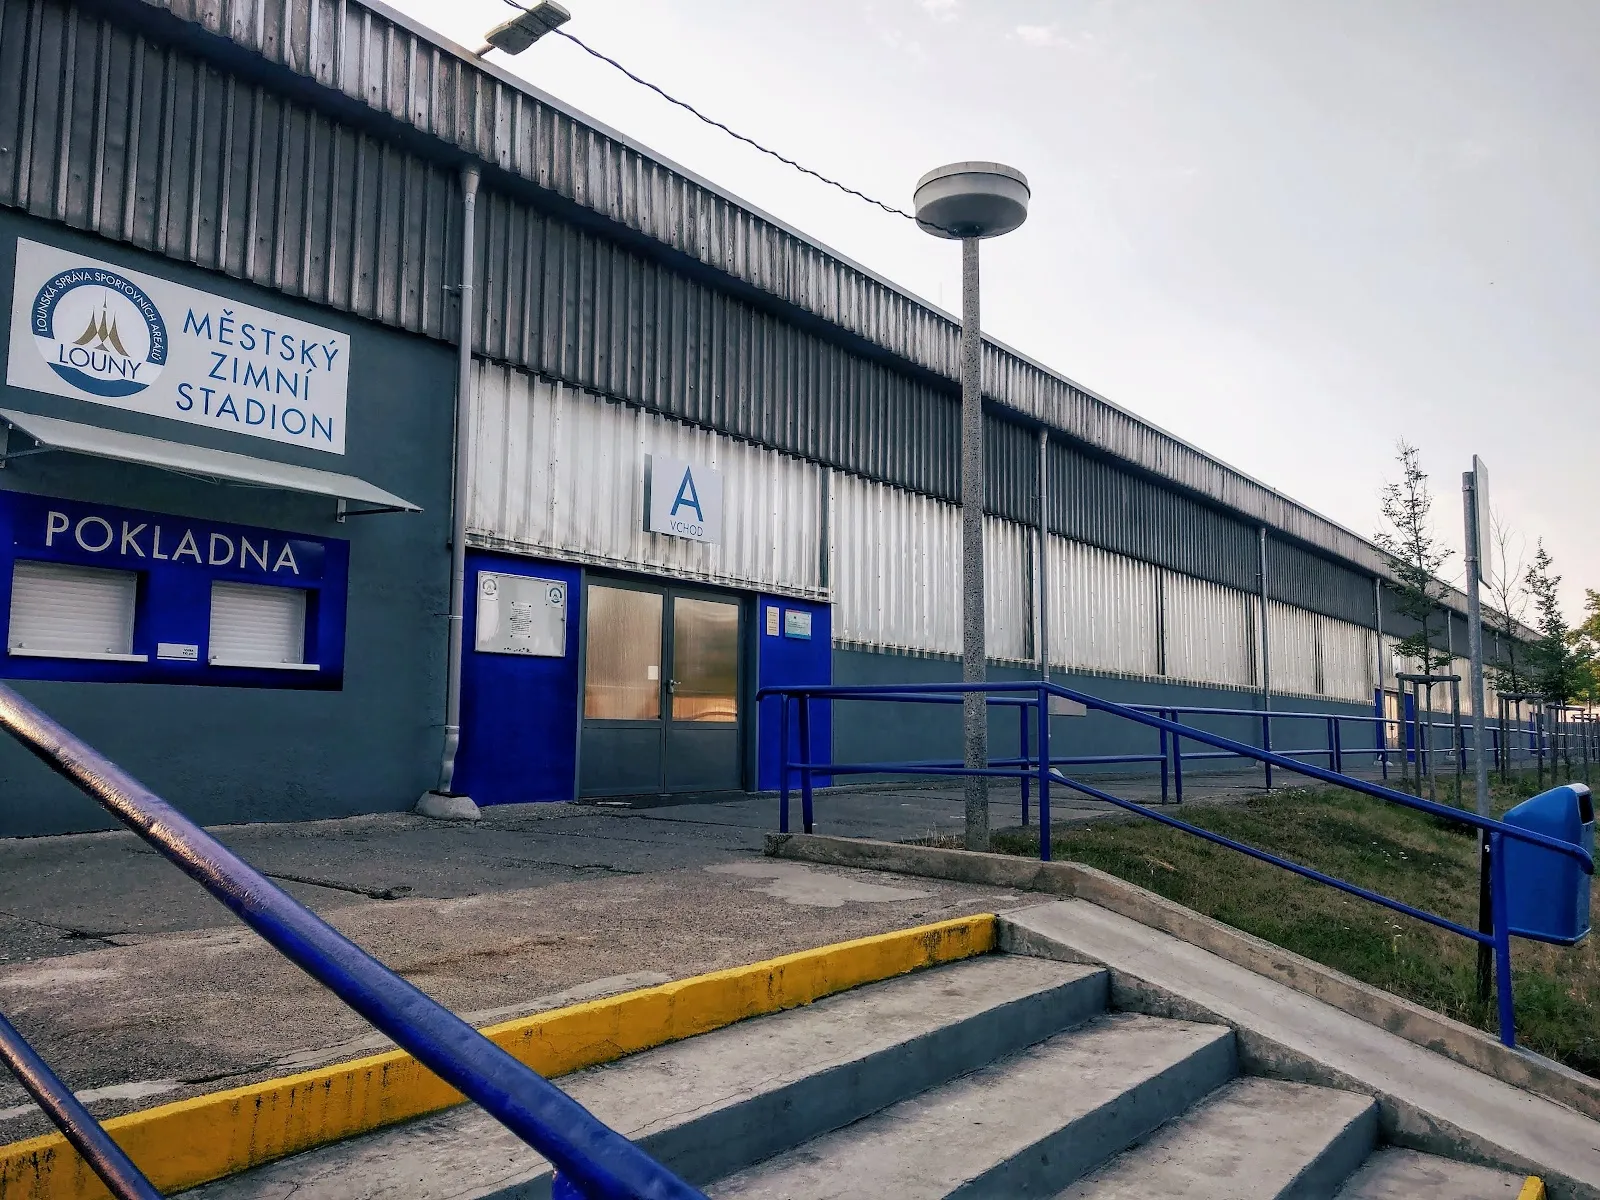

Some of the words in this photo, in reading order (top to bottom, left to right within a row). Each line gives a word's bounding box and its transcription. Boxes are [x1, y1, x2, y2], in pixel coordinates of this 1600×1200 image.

[36, 285, 58, 332] LOUNSKÁ
[55, 271, 92, 289] SPRÁVA
[94, 272, 156, 322] SPORTOVNÍCH
[59, 343, 142, 380] LOUNY
[183, 308, 338, 372] MĚSTSKÝ
[208, 351, 312, 401] ZIMNÍ
[175, 382, 333, 443] STADION
[670, 465, 704, 522] A
[45, 510, 300, 575] POKLADNA
[669, 520, 704, 537] VCHOD
